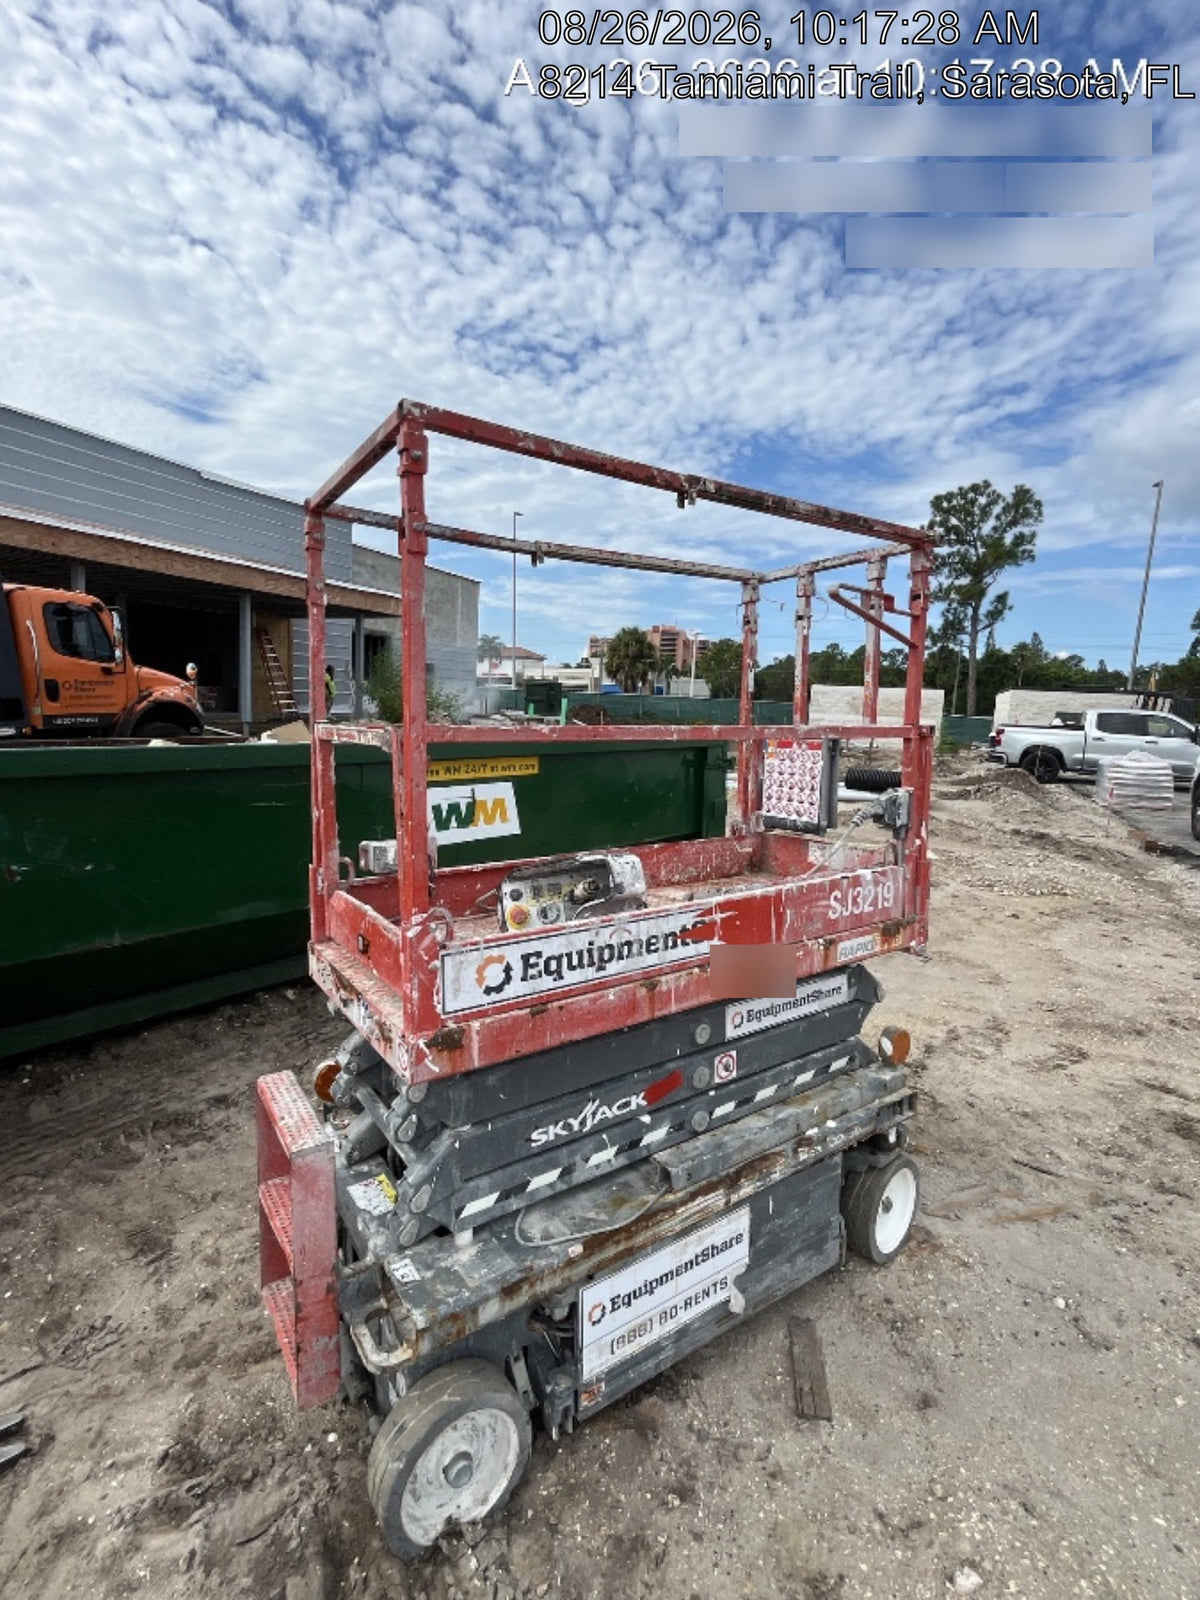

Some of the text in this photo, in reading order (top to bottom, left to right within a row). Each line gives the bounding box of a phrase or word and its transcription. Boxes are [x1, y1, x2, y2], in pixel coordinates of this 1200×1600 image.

[431, 797, 509, 832] WM
[828, 885, 895, 920] SJ3219
[746, 985, 842, 1023] EquipmentShare
[530, 1091, 648, 1147] SKYJACK
[609, 1232, 744, 1315] EquipmentShare
